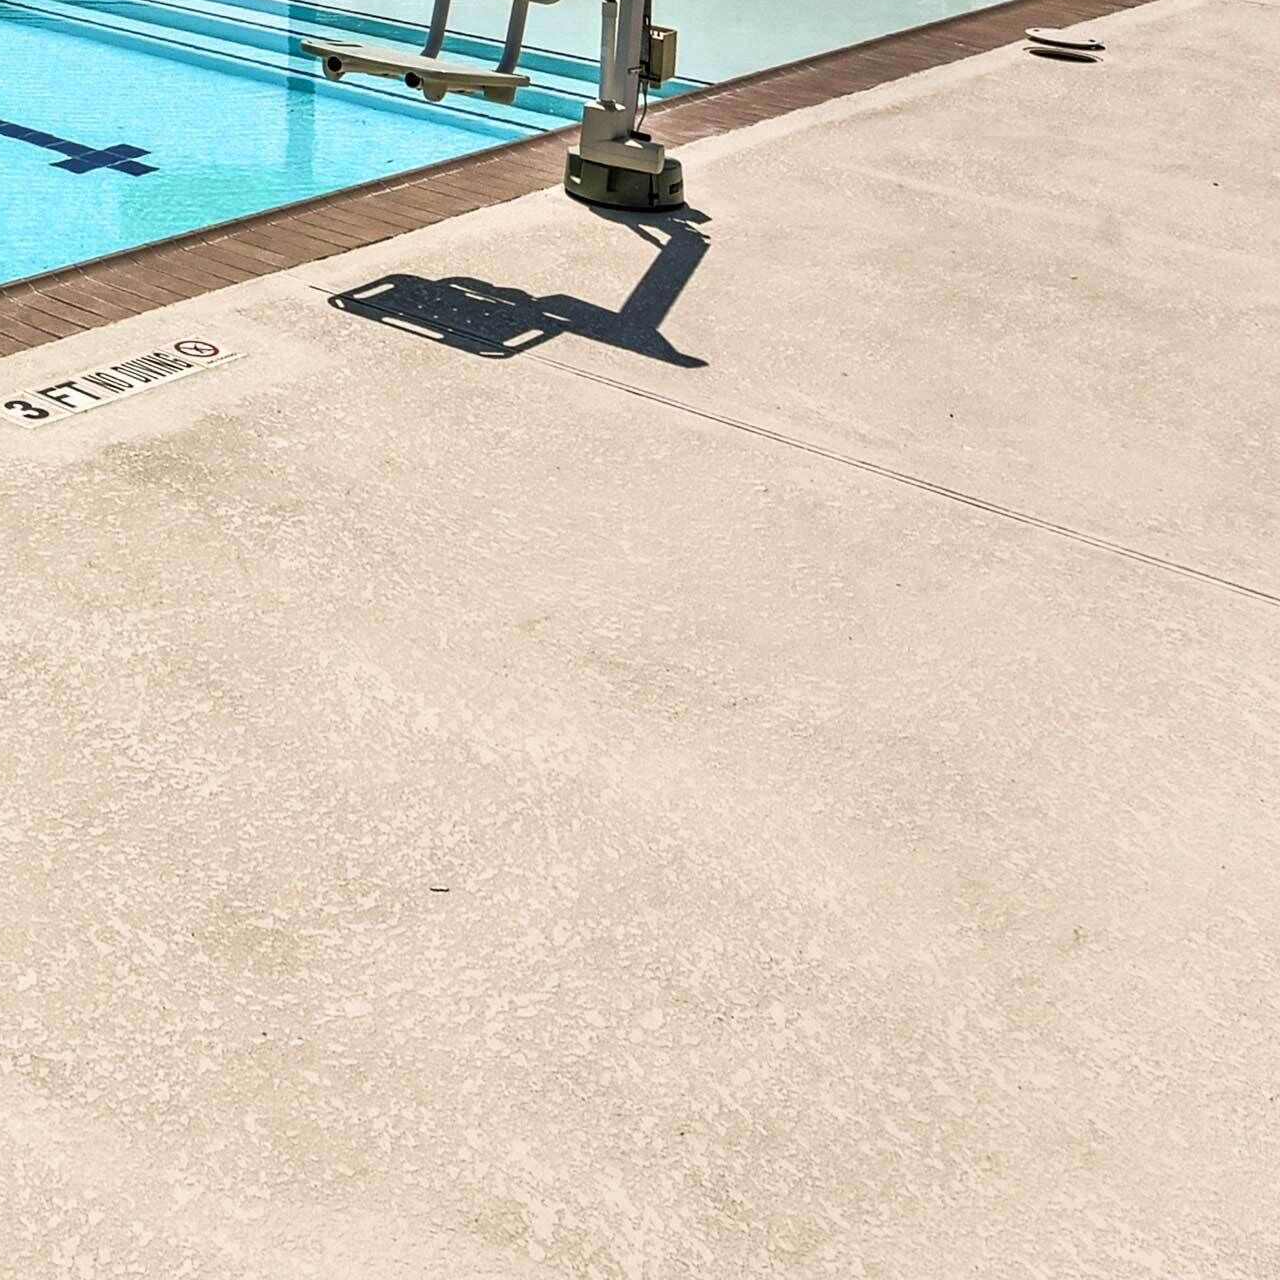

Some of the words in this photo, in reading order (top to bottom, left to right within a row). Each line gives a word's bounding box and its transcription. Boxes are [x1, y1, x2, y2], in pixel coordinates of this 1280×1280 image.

[4, 400, 50, 420] 3
[37, 381, 102, 409] FT
[81, 372, 135, 394] NO
[111, 352, 194, 383] DIVING
